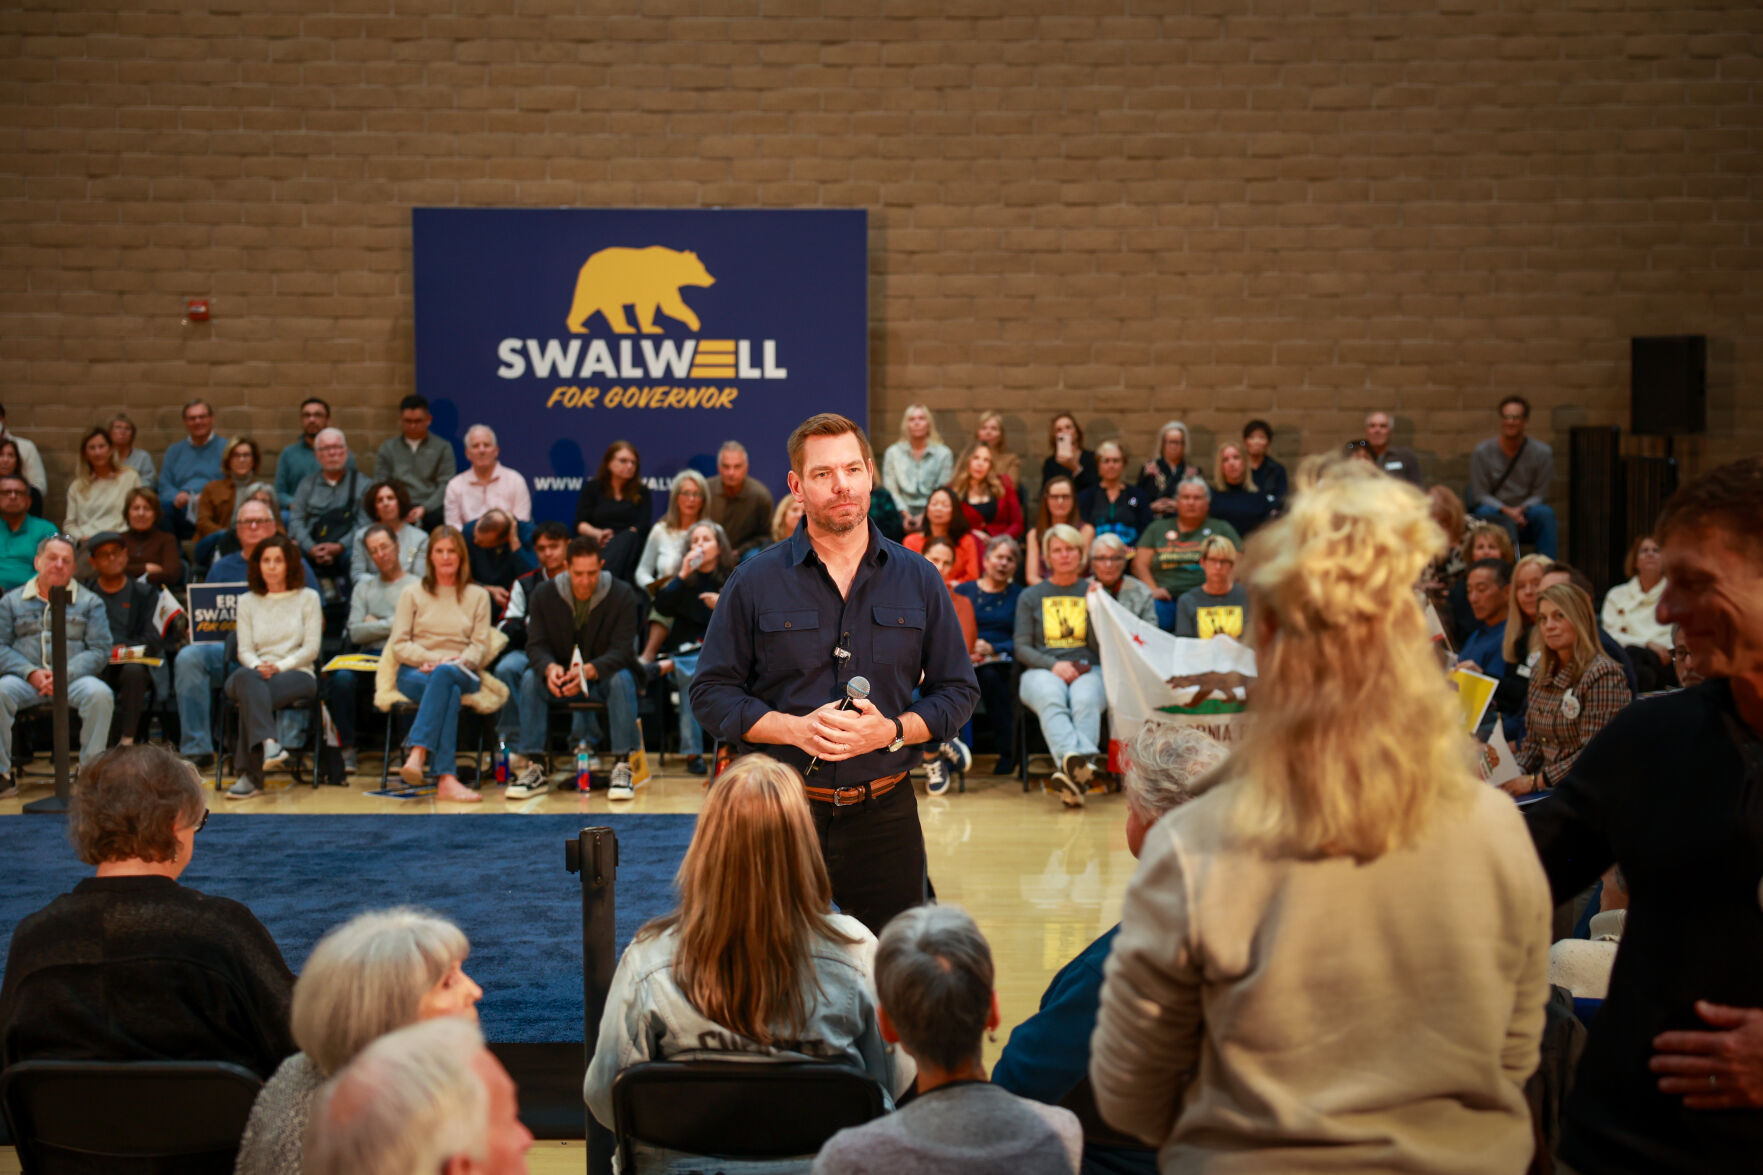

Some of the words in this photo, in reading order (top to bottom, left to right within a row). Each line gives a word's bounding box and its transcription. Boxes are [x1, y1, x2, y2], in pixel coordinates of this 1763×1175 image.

[497, 338, 787, 379] SWALWELL
[546, 386, 600, 408] FOR
[603, 386, 738, 409] GOVERNOR
[194, 608, 238, 622] SWAL
